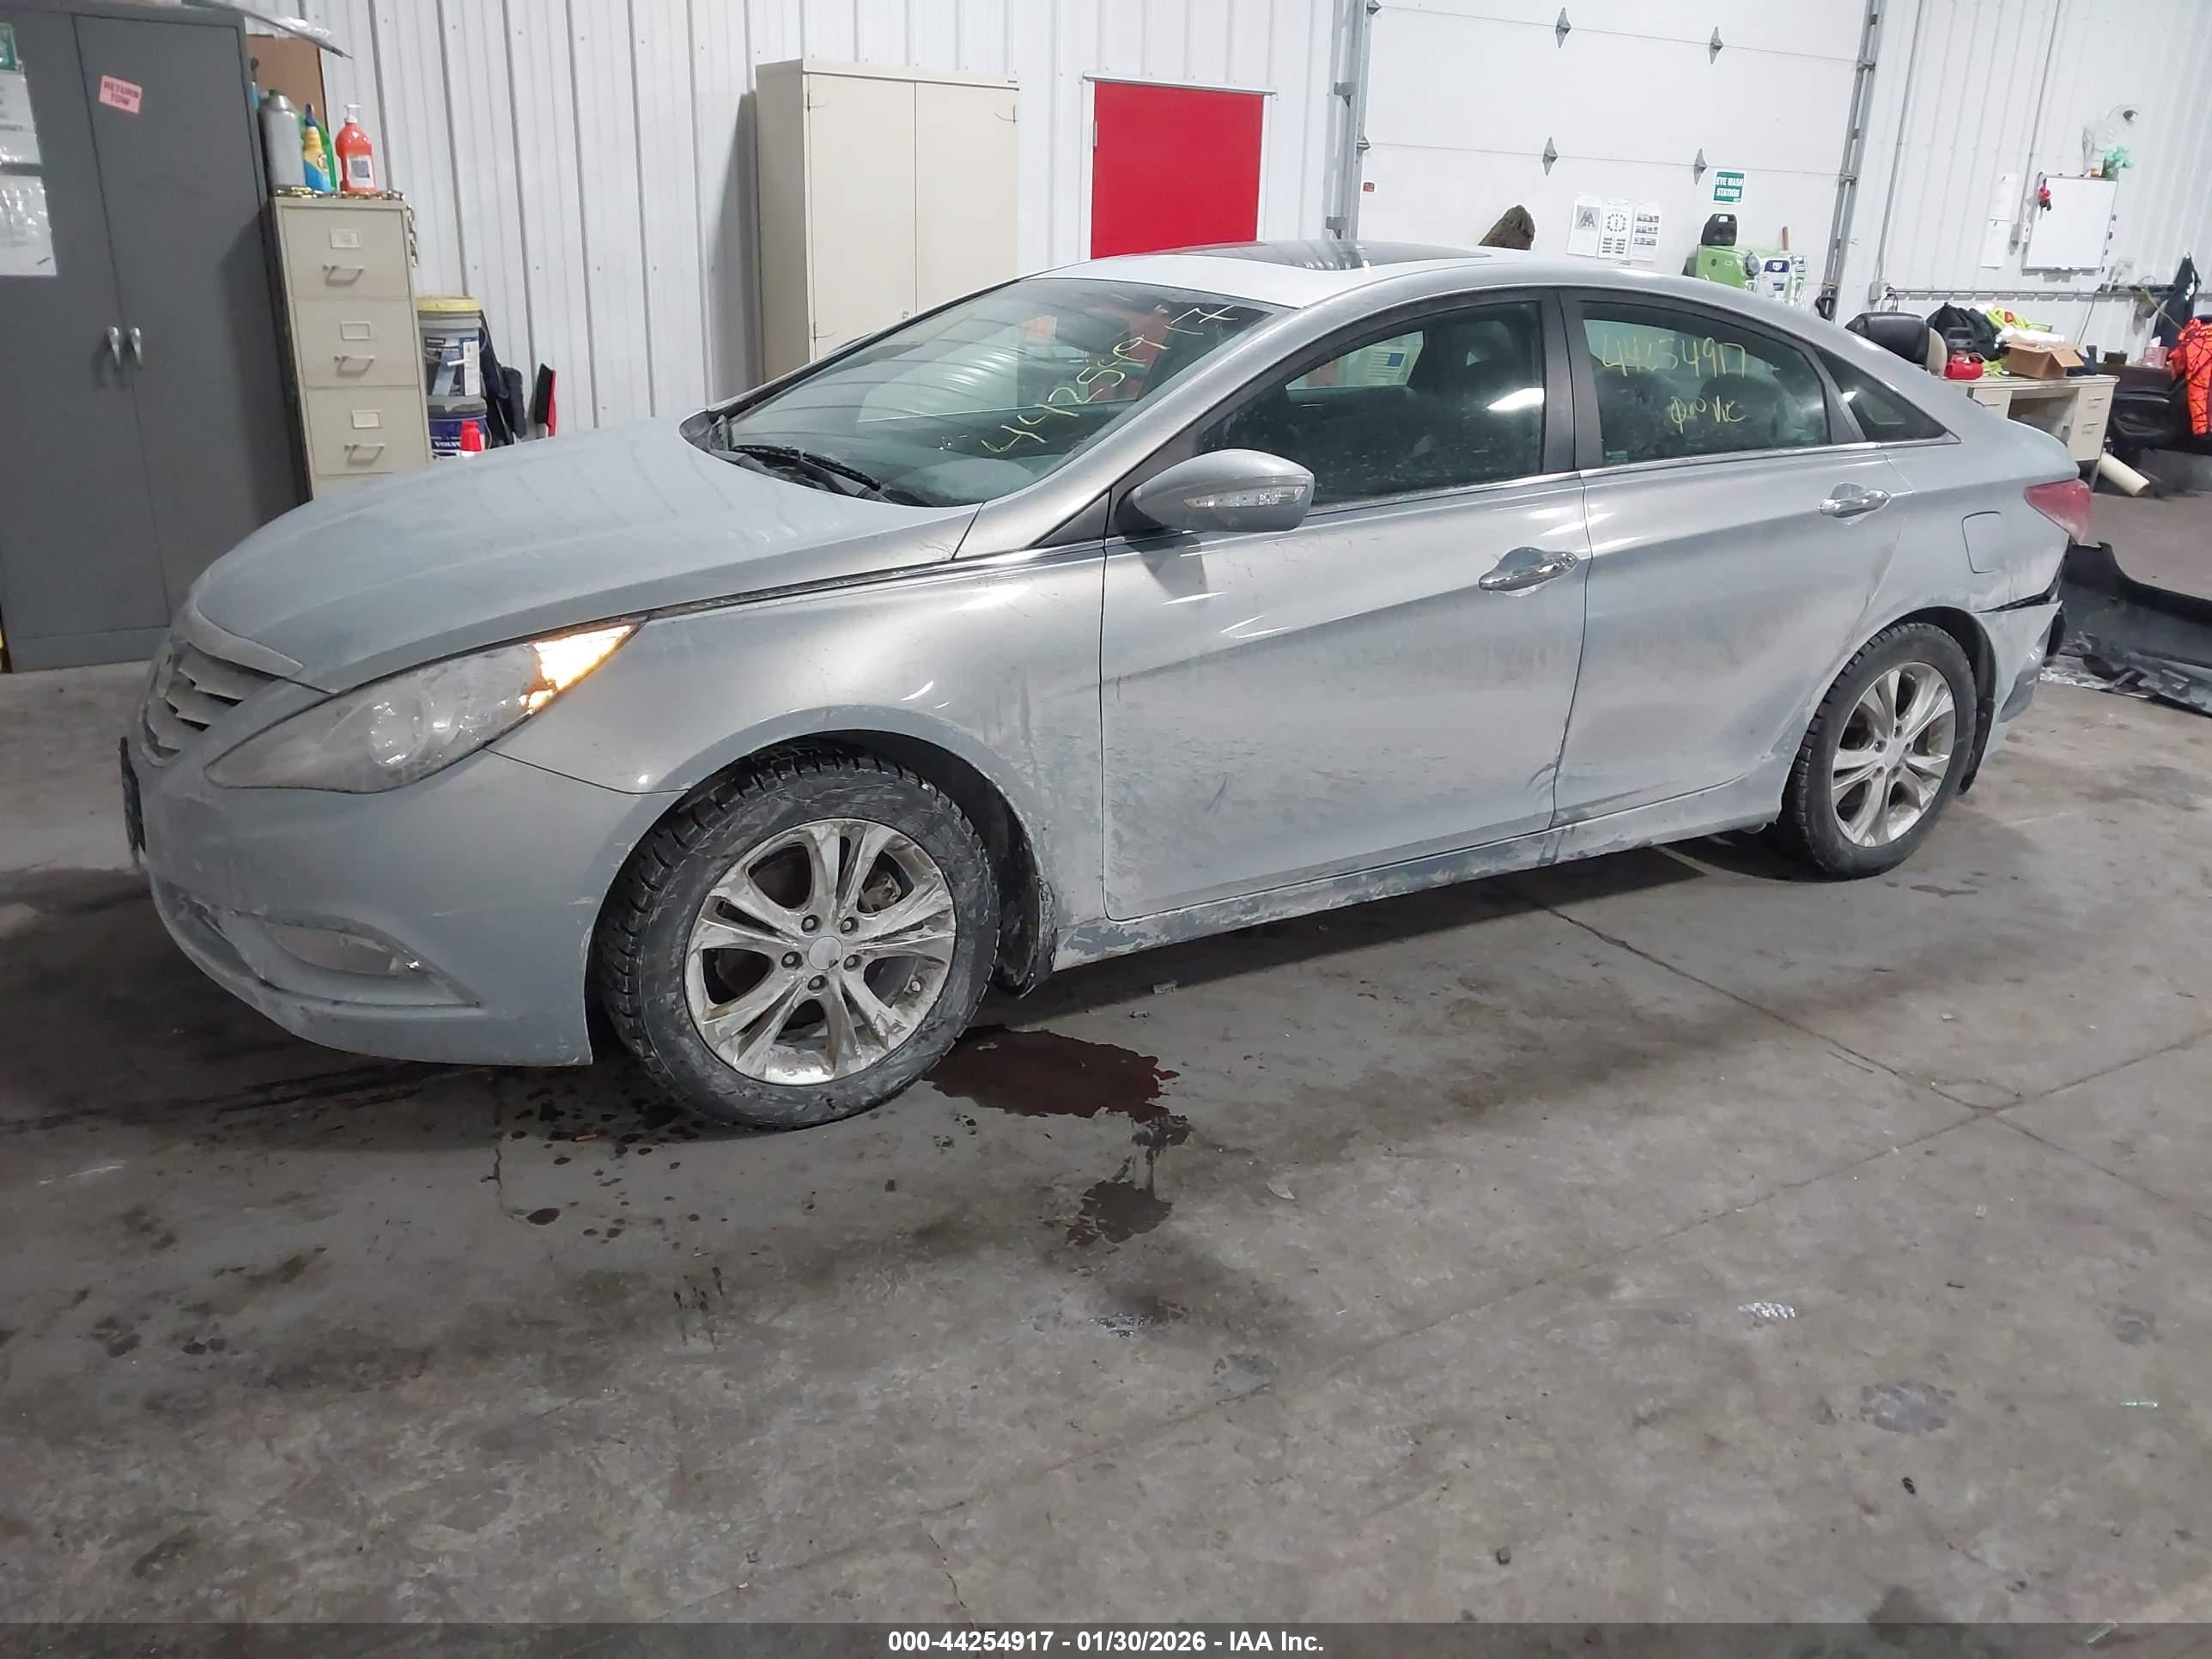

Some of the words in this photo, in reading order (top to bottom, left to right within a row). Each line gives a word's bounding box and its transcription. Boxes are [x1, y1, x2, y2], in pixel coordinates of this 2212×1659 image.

[104, 81, 139, 99] RETURN
[111, 93, 131, 105] TOW
[1717, 177, 1727, 185] EYE
[1728, 178, 1743, 186] WASH
[1717, 188, 1741, 198] STATION
